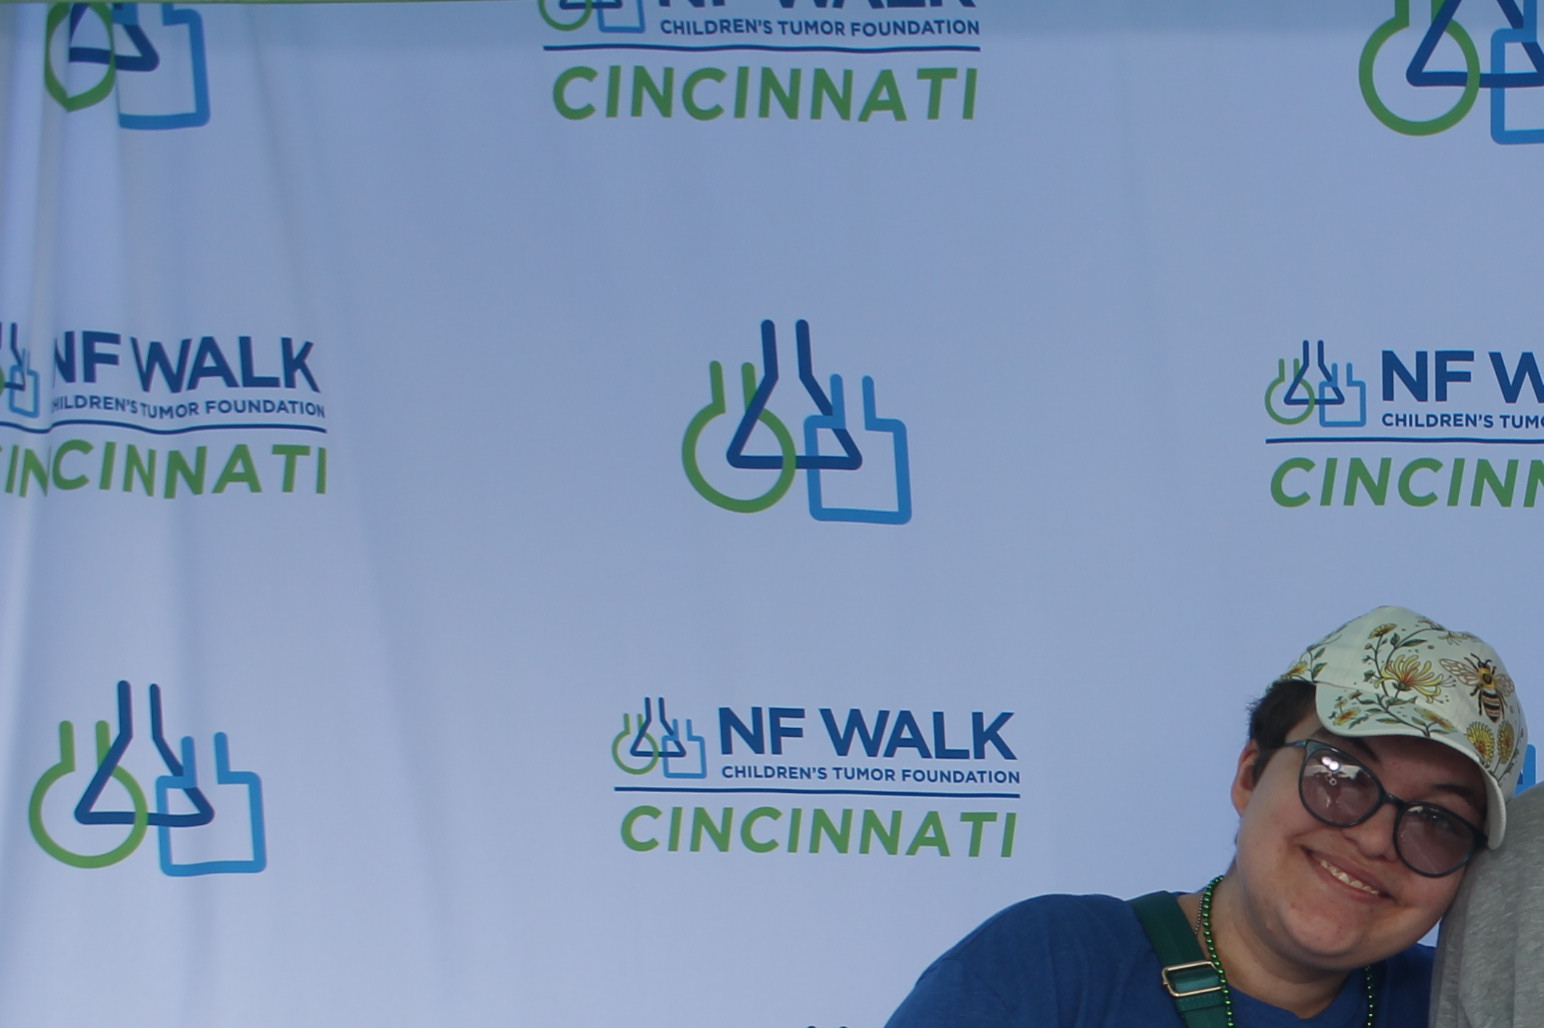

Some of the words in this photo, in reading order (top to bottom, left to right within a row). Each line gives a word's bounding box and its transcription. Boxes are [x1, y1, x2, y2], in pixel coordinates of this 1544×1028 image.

[660, 18, 773, 36] CHILDREN'S
[777, 20, 846, 37] TUMOR
[851, 19, 981, 37] FOUNDATION
[552, 65, 979, 122] CINCINNATI
[53, 330, 121, 384] NF
[130, 336, 322, 394] WALK
[1381, 349, 1475, 403] NF
[51, 394, 139, 414] HILDREN'S
[140, 400, 200, 419] TUMOR
[206, 399, 326, 419] FOUNDATION
[1381, 411, 1495, 429] CHILDREN'S
[0, 439, 327, 500] INCINNATI
[718, 706, 806, 756] NF
[819, 707, 1018, 761] WALK
[721, 765, 829, 781] CHILDREN'S
[832, 766, 896, 782] TUMOR
[901, 768, 1021, 785] FOUNDATION
[620, 805, 1017, 858] CINCINNATI
